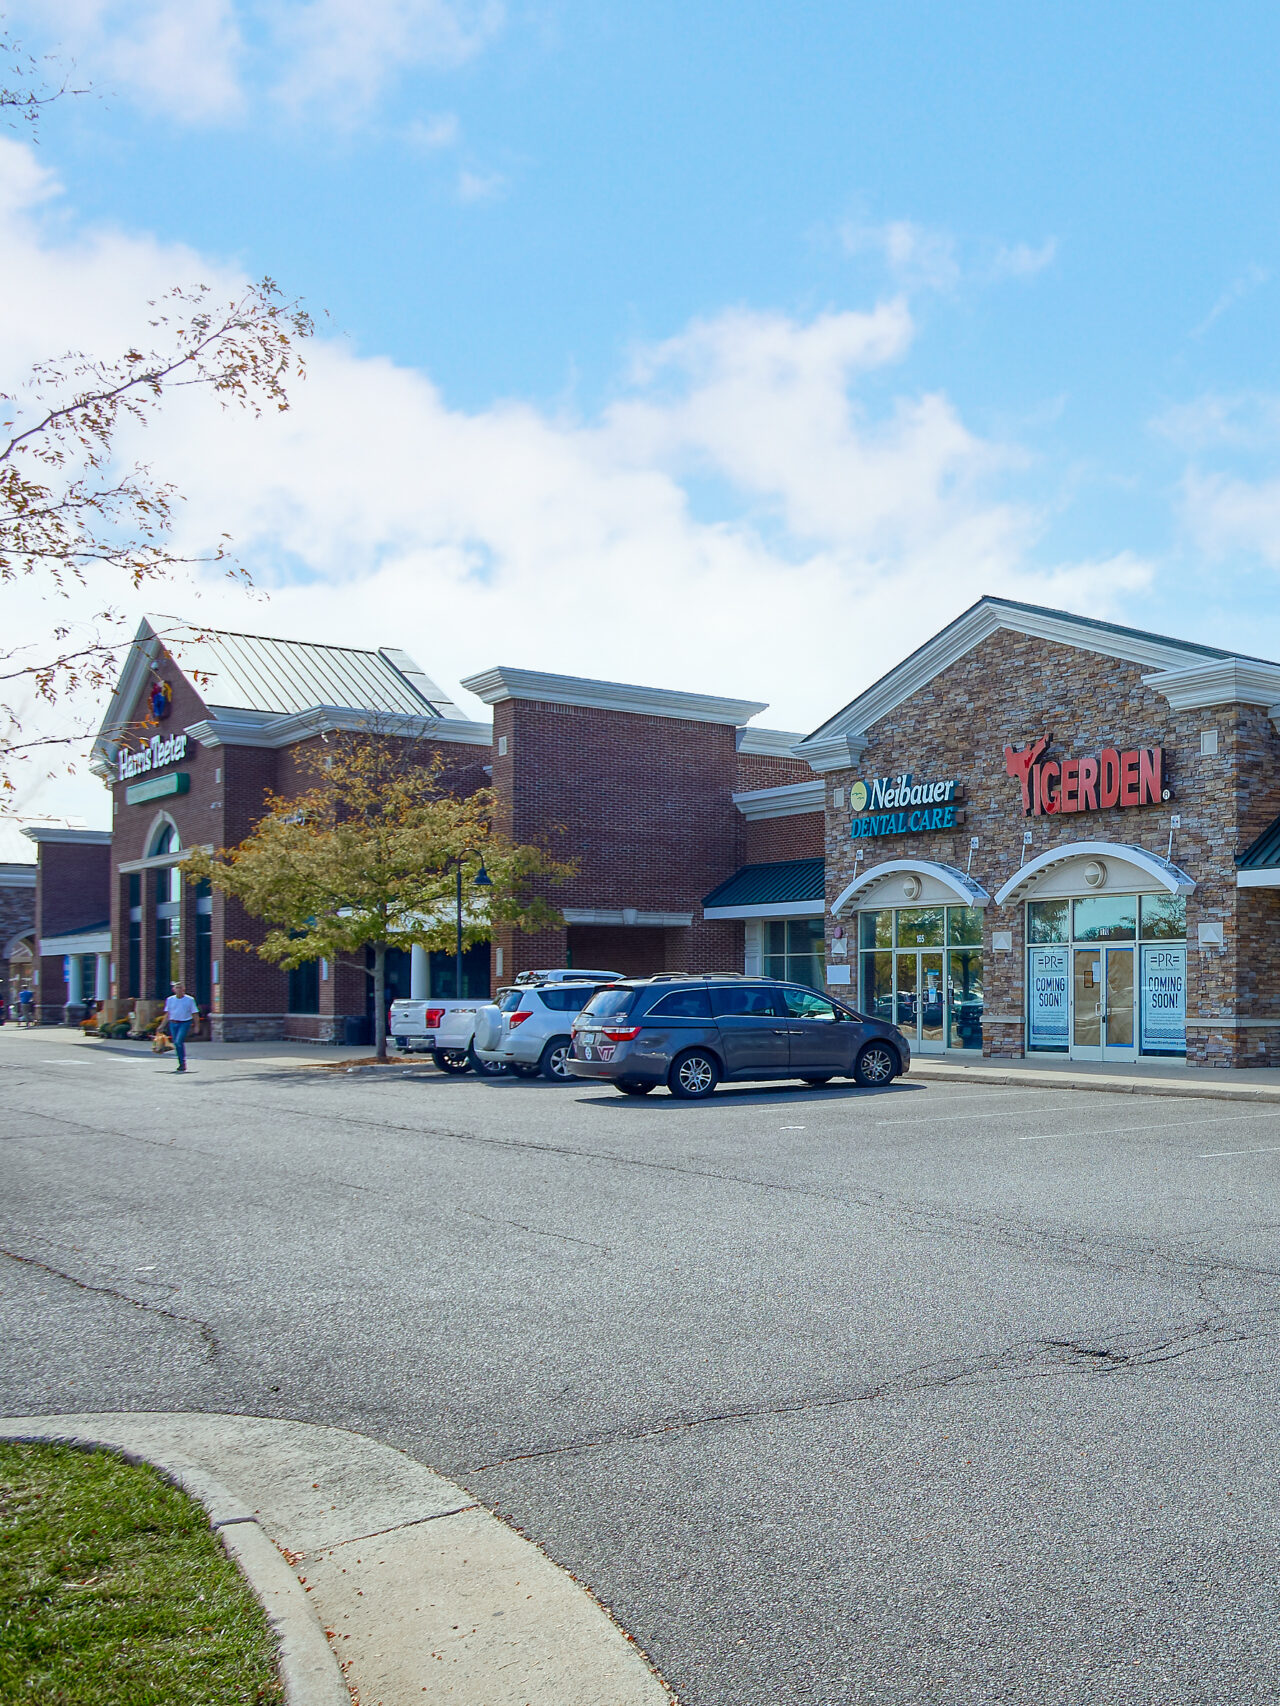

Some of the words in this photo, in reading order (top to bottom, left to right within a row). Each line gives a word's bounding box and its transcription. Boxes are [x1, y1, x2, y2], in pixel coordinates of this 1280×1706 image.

[119, 744, 152, 780] Harris
[150, 734, 186, 768] Teeter
[869, 774, 954, 810] Neibauer
[851, 811, 908, 839] DENTAL
[909, 806, 956, 831] CARE
[1035, 977, 1066, 992] COMING
[1148, 976, 1183, 992] COMING
[1038, 992, 1063, 1007] SOON!
[1151, 993, 1179, 1009] SOON!
